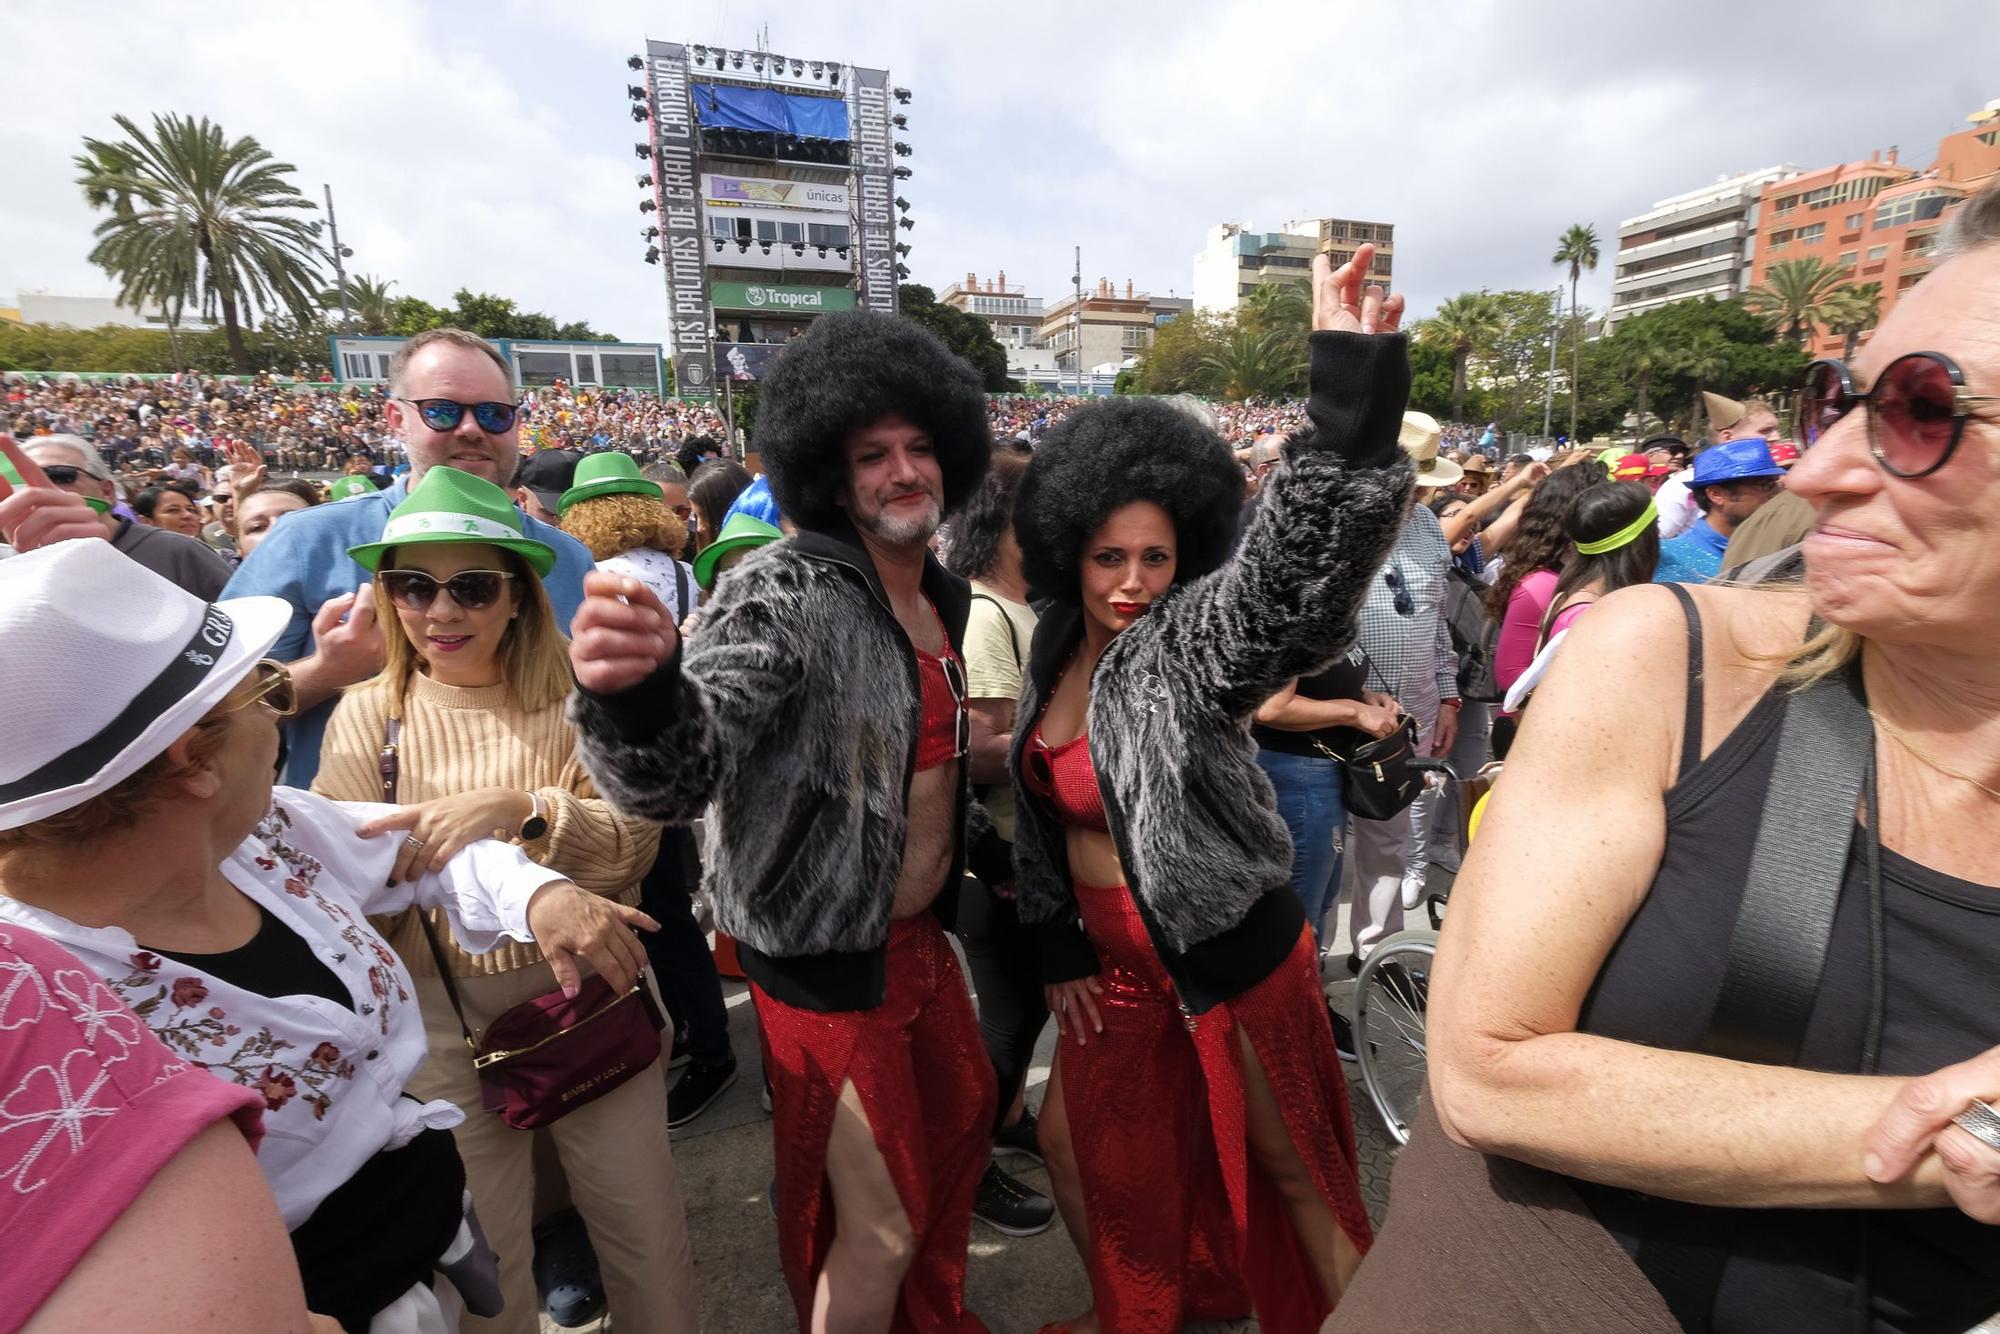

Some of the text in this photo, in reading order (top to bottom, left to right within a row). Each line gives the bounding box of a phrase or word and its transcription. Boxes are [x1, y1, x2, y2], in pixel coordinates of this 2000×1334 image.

[655, 60, 690, 139] CANARIA
[859, 86, 888, 168] CANARIA
[663, 145, 694, 200] GRAN
[807, 188, 844, 203] únicas
[863, 174, 889, 224] GRAN
[668, 205, 698, 230] DE
[866, 230, 890, 251] DE
[670, 236, 704, 314] PALMAS
[765, 288, 822, 307] Tropical
[677, 320, 707, 353] LAS
